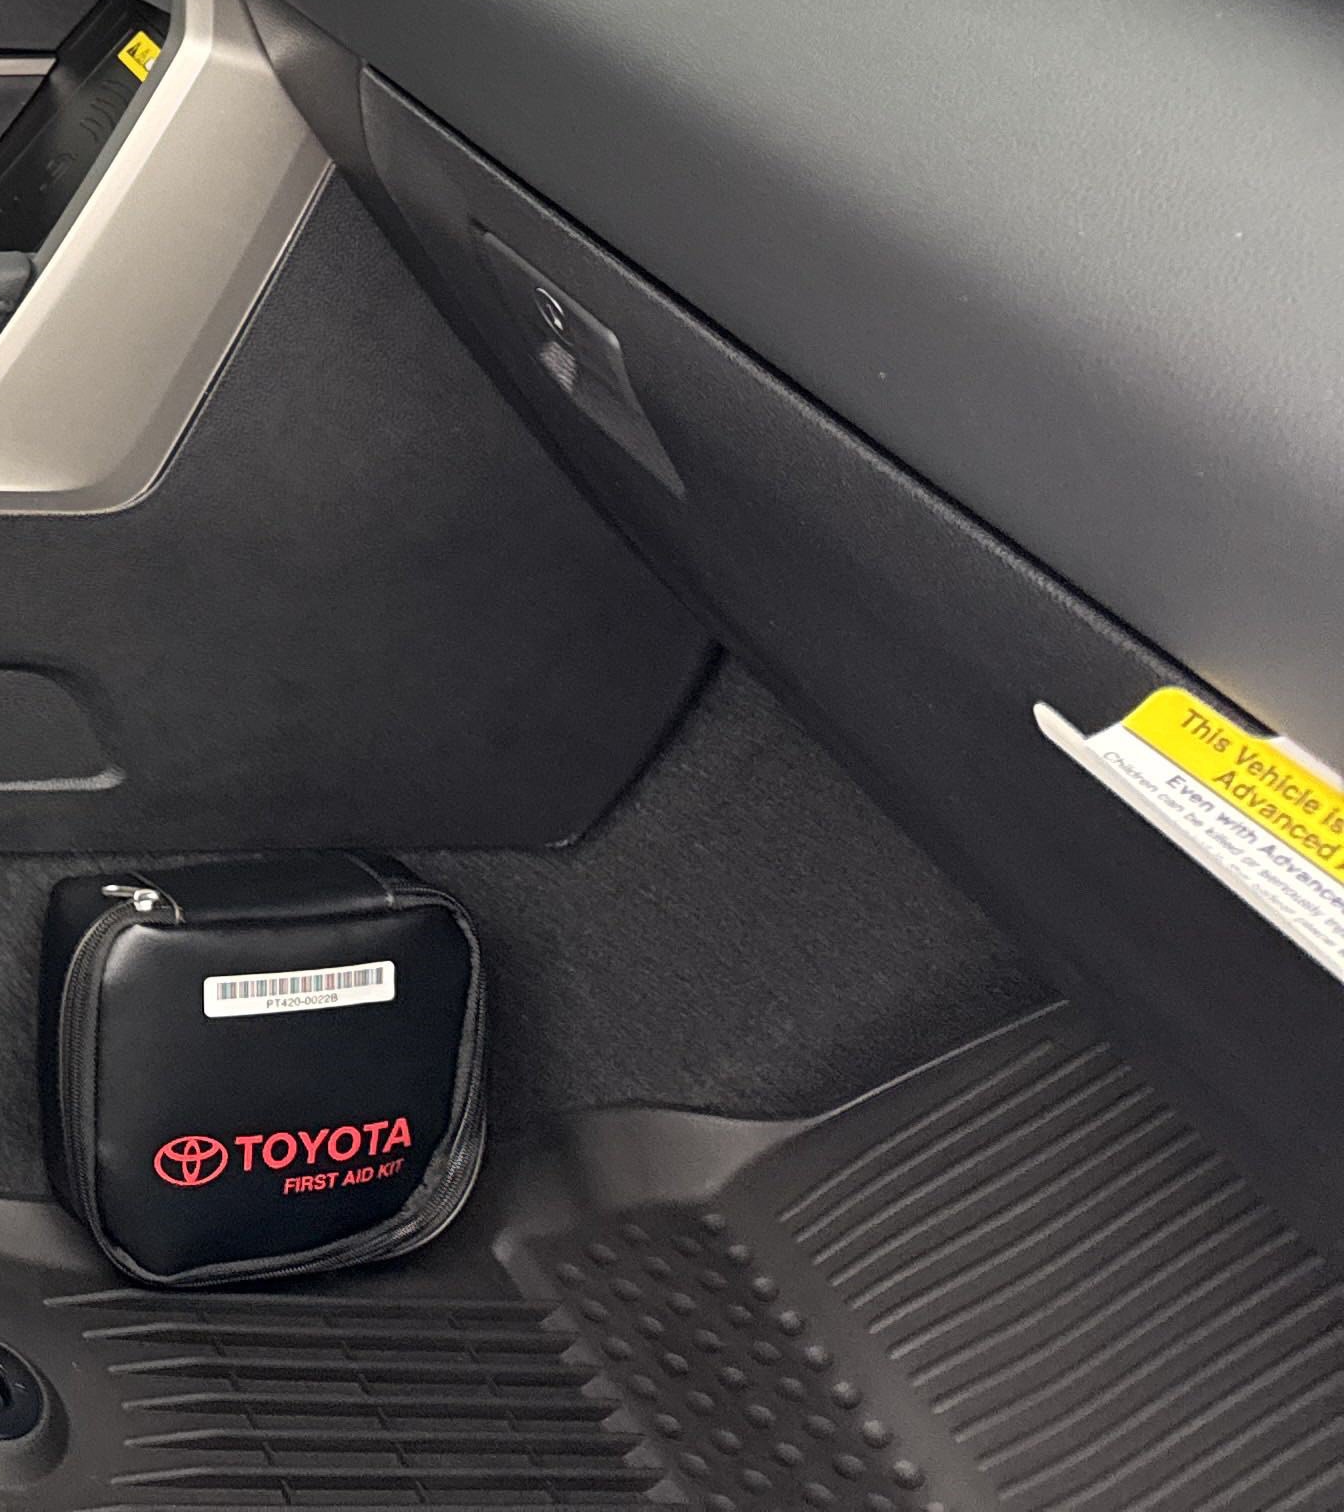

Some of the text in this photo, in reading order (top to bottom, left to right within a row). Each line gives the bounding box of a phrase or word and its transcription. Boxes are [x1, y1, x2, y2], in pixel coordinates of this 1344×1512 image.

[1102, 750, 1159, 794] Children
[1179, 708, 1344, 836] This Vehicle is
[1212, 769, 1338, 861] Advanced
[1165, 774, 1212, 813] Even
[1216, 810, 1257, 845] with
[1257, 843, 1344, 916] Advance
[266, 993, 339, 1009] PT420-0022B
[235, 1117, 412, 1172] TOYOTA
[283, 1158, 405, 1195] FIRST AID KIT
